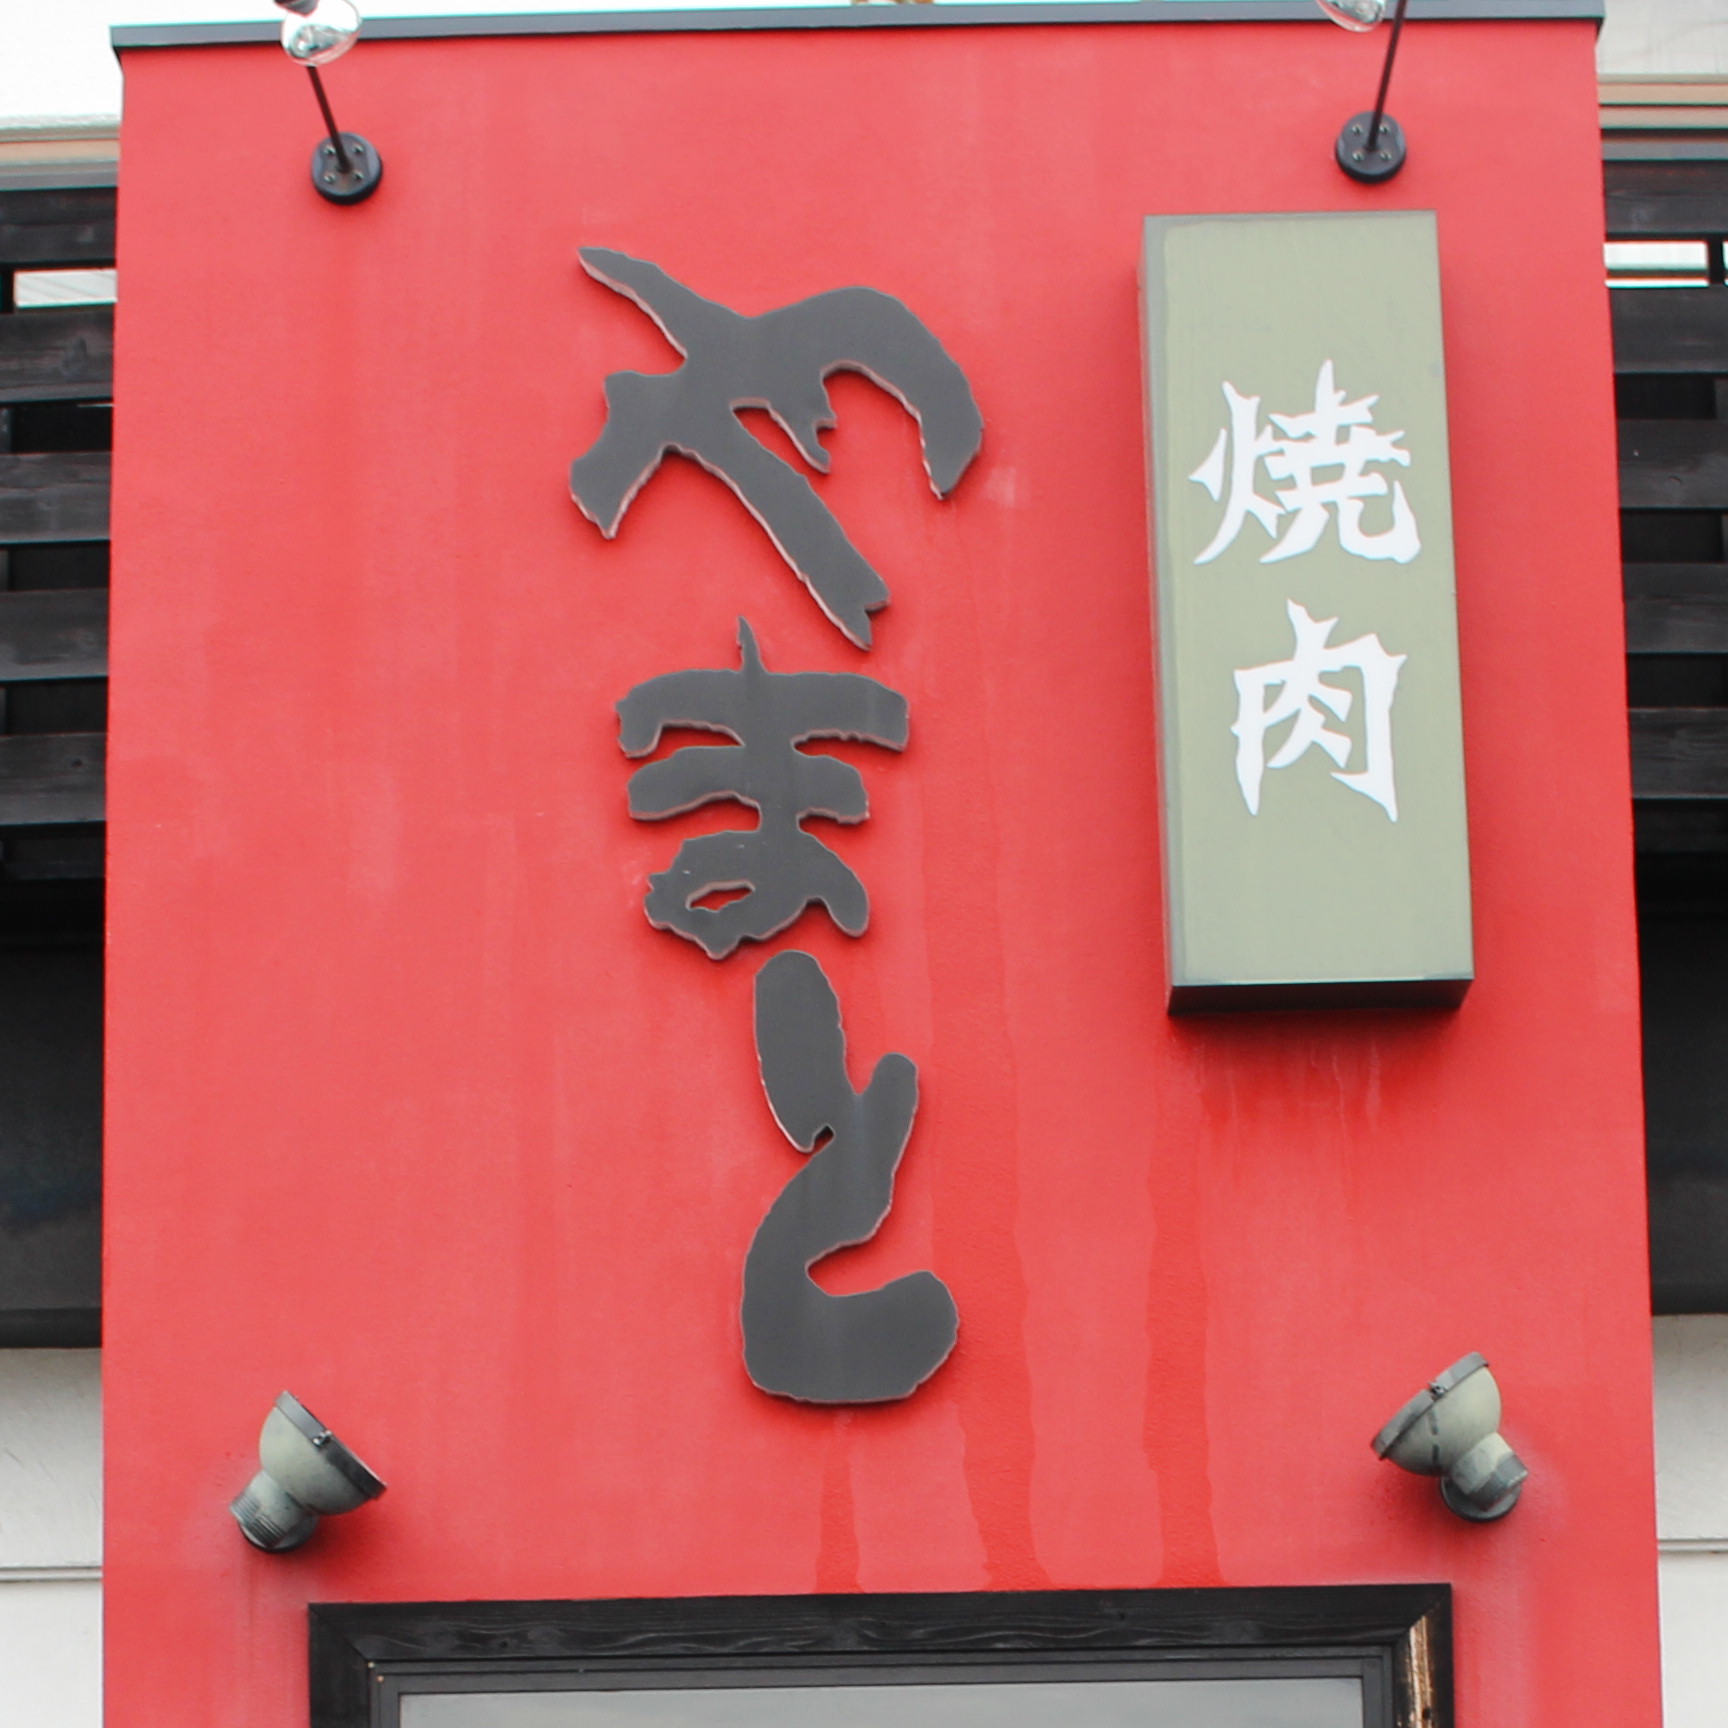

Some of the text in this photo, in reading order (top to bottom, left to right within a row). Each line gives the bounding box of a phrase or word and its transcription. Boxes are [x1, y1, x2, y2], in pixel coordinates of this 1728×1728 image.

[568, 247, 983, 1404] やまと
[1188, 360, 1421, 823] 焼肉
